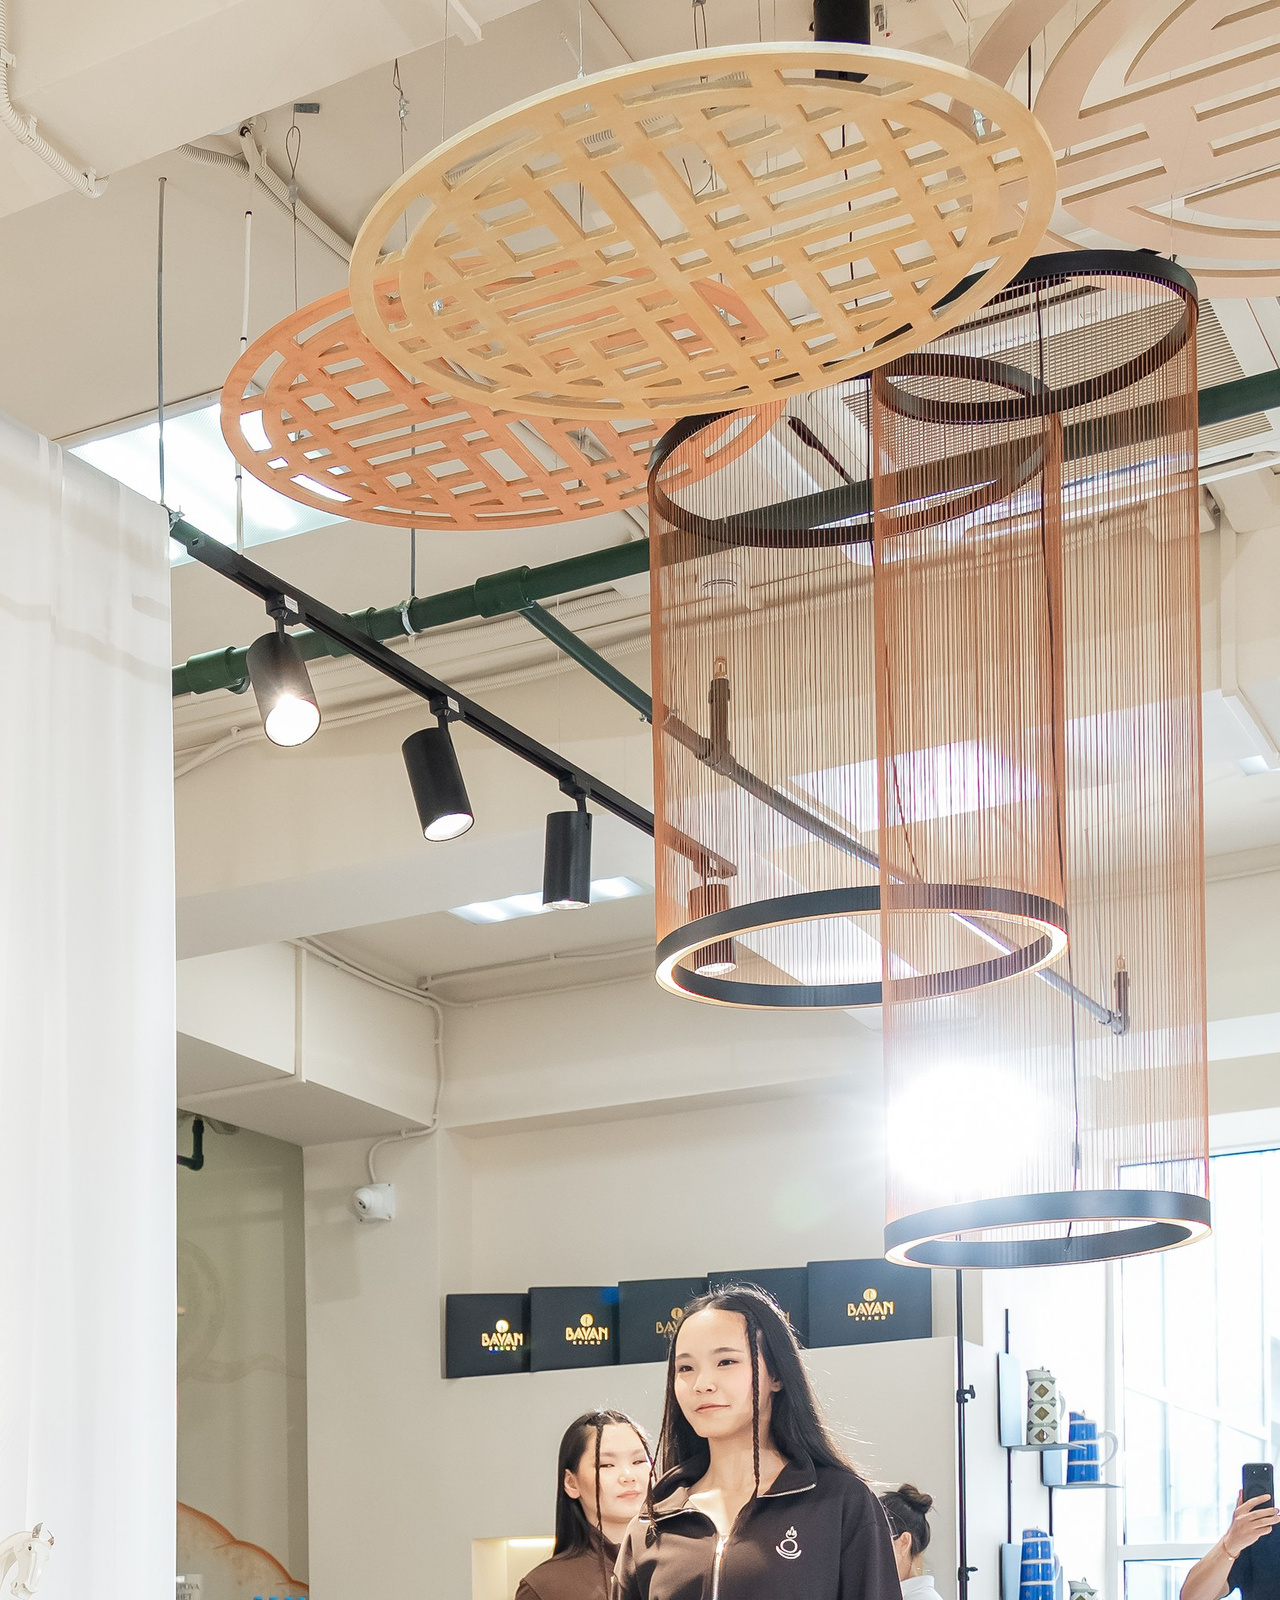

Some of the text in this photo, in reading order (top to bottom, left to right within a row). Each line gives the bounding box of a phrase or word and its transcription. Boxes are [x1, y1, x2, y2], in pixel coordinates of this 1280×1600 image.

[847, 1300, 895, 1317] BAYAN
[482, 1332, 524, 1347] BAYAN
[565, 1326, 609, 1341] BAYAN
